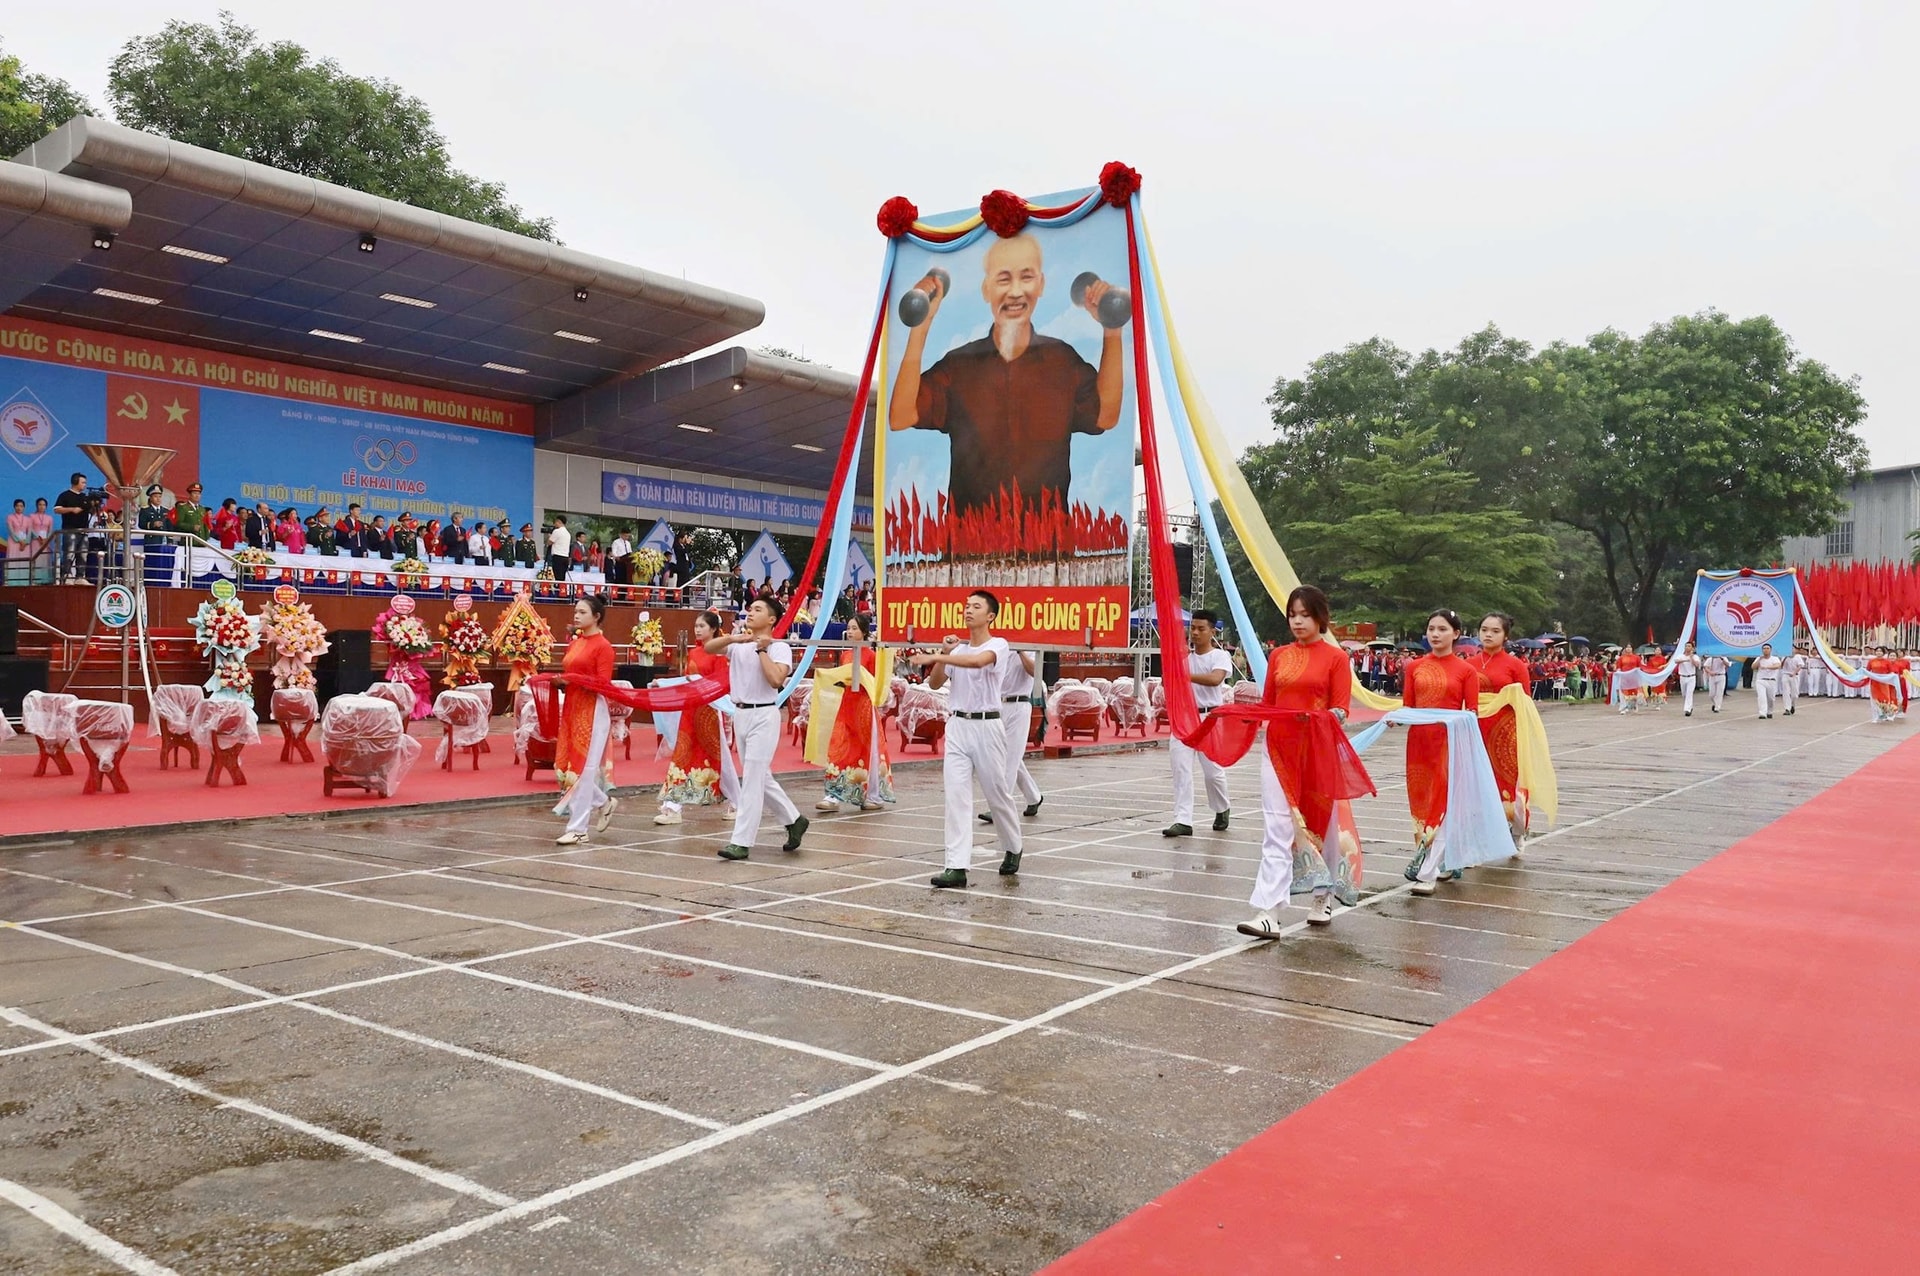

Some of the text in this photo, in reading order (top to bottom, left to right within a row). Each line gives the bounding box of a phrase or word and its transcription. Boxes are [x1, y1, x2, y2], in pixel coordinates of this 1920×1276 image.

[56, 338, 117, 364] CỘNG
[123, 349, 165, 372] HÒA
[172, 357, 198, 377] XÃ
[204, 362, 236, 385] HỘI
[242, 368, 279, 389] CHỦ
[284, 375, 338, 399] NGHĨA
[343, 386, 377, 406] VIỆT
[382, 392, 418, 412] NAM
[423, 399, 467, 421] MUÔN
[471, 406, 504, 425] NĂM
[241, 481, 265, 500] ĐẠI
[267, 483, 289, 503] HỘI
[370, 495, 399, 511] THAO
[402, 498, 446, 516] PHƯỜNG
[342, 467, 427, 496] LỄ KHAI MẠC
[636, 482, 661, 501] TOÀN
[664, 484, 684, 505] DÂN
[686, 487, 705, 507] RÈN
[708, 491, 736, 513] LUYỆN
[738, 495, 760, 513] THÂN
[780, 503, 800, 518] THEO
[802, 504, 823, 521] GƯƠN
[888, 596, 1122, 638] TỰ TÔI NG NÀO CŨNG TẬP
